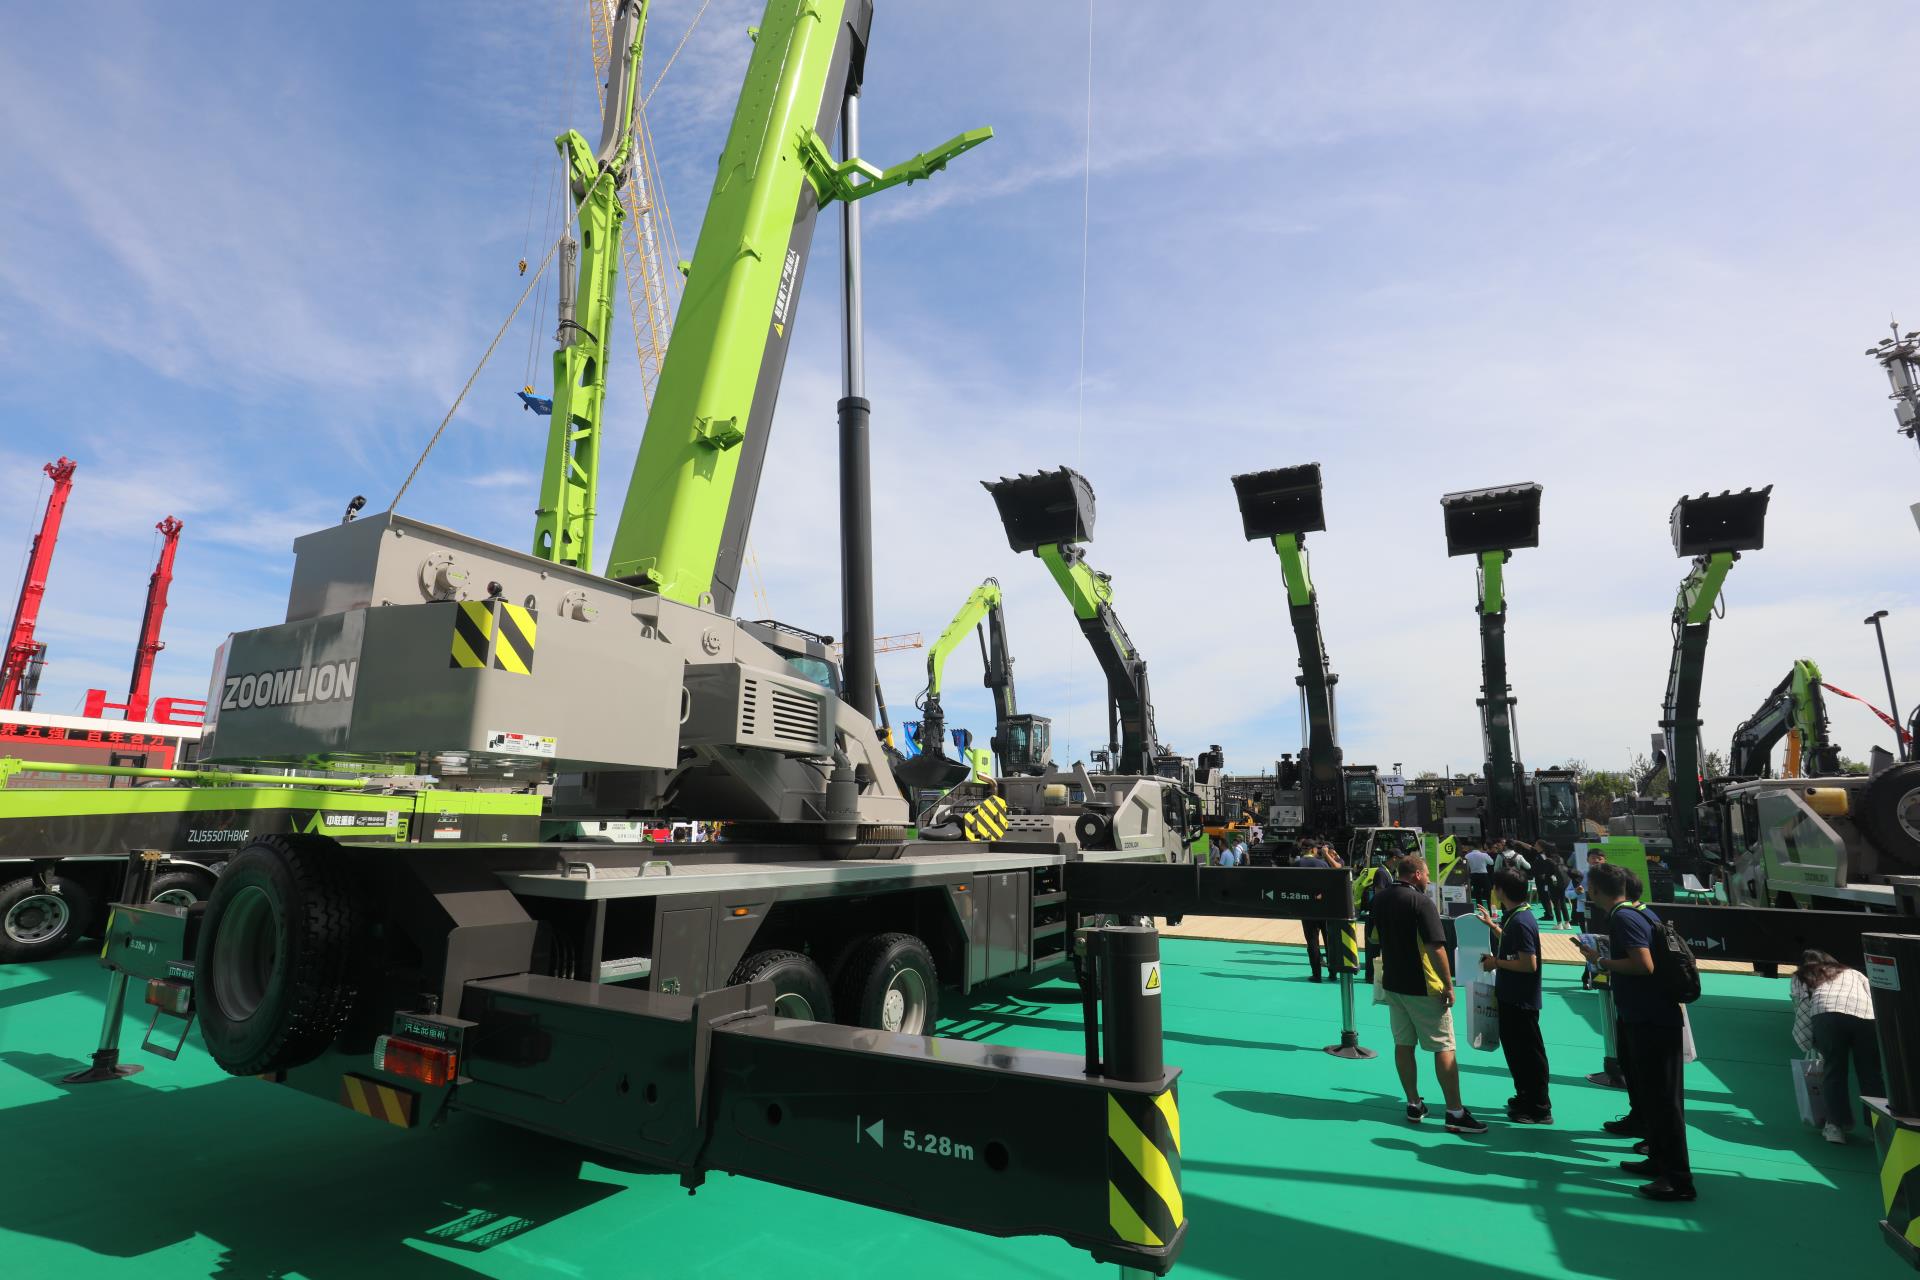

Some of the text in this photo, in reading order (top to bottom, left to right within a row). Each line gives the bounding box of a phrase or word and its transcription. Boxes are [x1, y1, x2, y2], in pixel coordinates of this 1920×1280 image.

[222, 661, 357, 710] ZOOMLION
[1281, 892, 1309, 900] 5.28m
[903, 1129, 974, 1161] 5.28m
